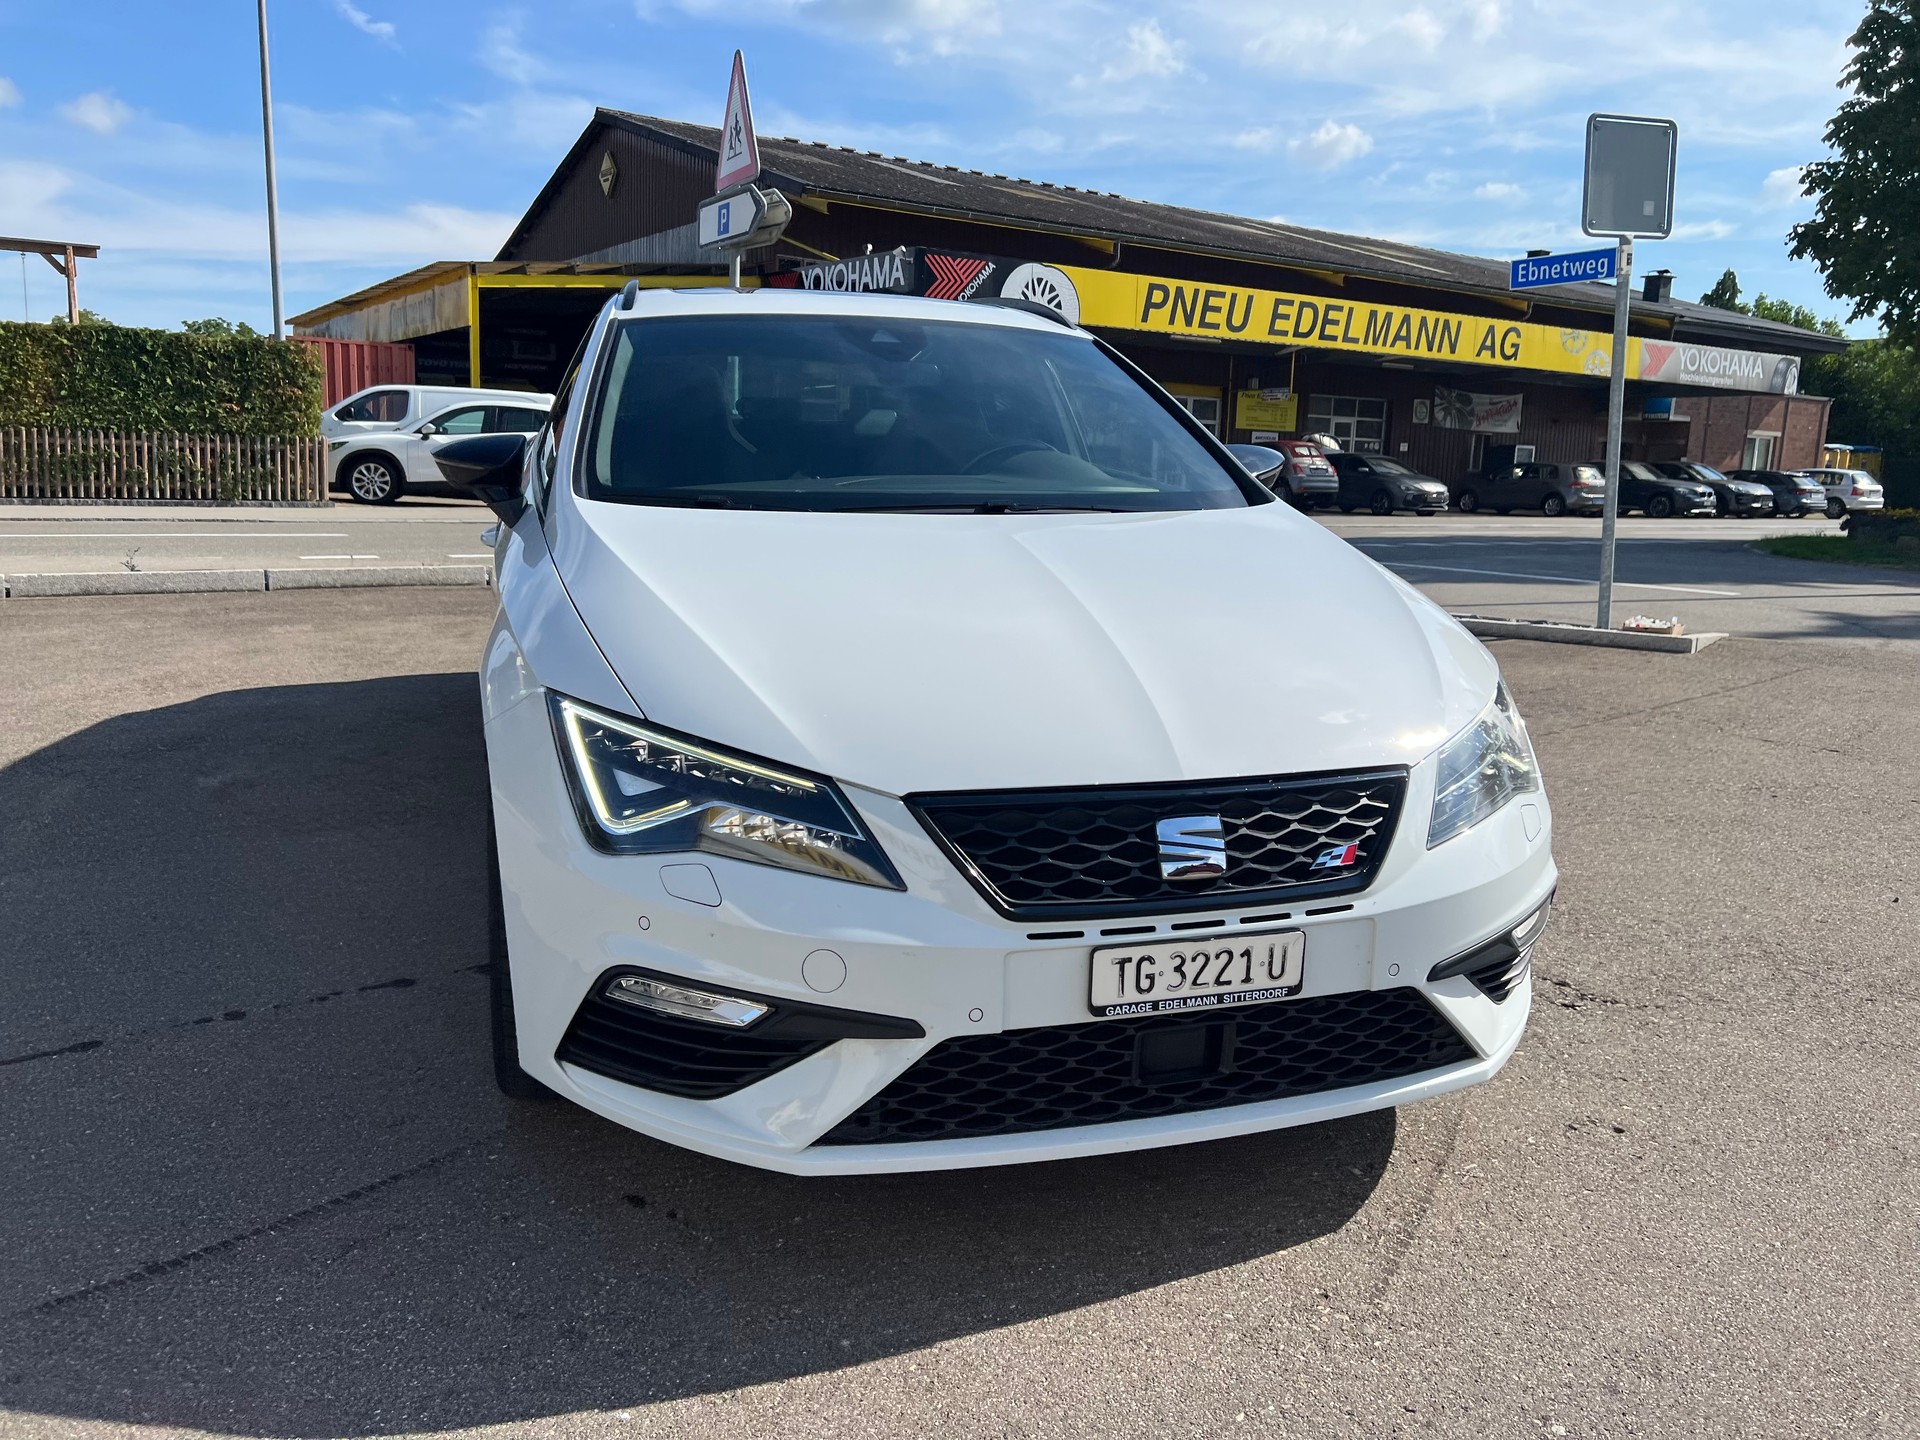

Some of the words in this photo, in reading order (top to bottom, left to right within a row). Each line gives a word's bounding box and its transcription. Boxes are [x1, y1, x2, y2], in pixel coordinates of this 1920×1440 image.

[720, 209, 727, 231] P
[802, 255, 904, 291] YOKOHAMA
[957, 261, 996, 301] OKOHAMA
[1518, 258, 1608, 282] Ebnetweg
[1141, 283, 1254, 333] PNEU
[1267, 297, 1462, 355] EDELMANN
[1476, 325, 1521, 361] AG
[1680, 347, 1763, 378] YOKOHAMA
[1680, 372, 1733, 386] Hochleistungsreifen
[1106, 1002, 1153, 1016] GARAGE
[1158, 996, 1218, 1011] EDELMANN
[1223, 988, 1289, 1003] SITTERDORF
